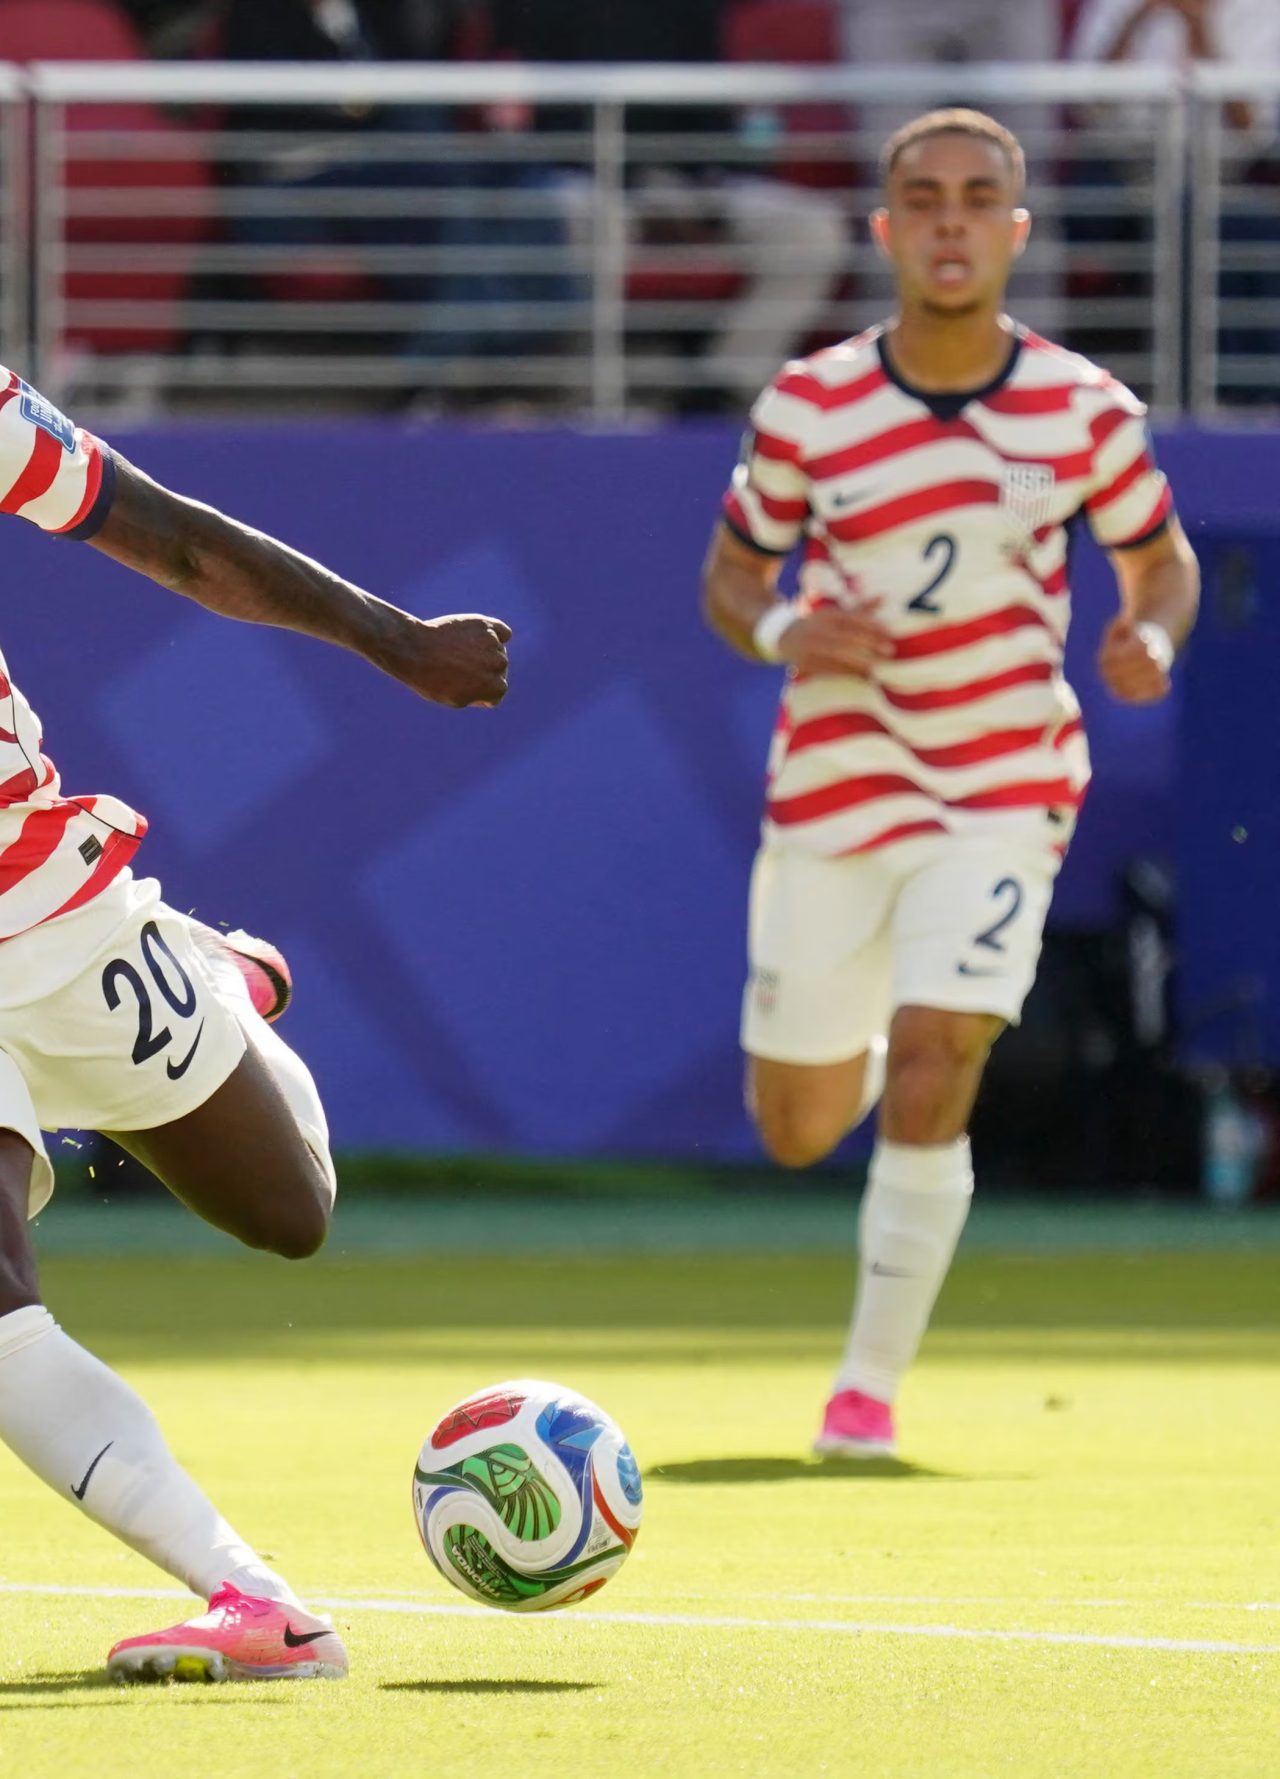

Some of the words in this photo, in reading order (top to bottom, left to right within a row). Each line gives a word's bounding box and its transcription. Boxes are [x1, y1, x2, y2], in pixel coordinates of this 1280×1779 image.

[908, 533, 957, 614] 2
[974, 877, 1023, 951] 2
[102, 921, 197, 1065] 20
